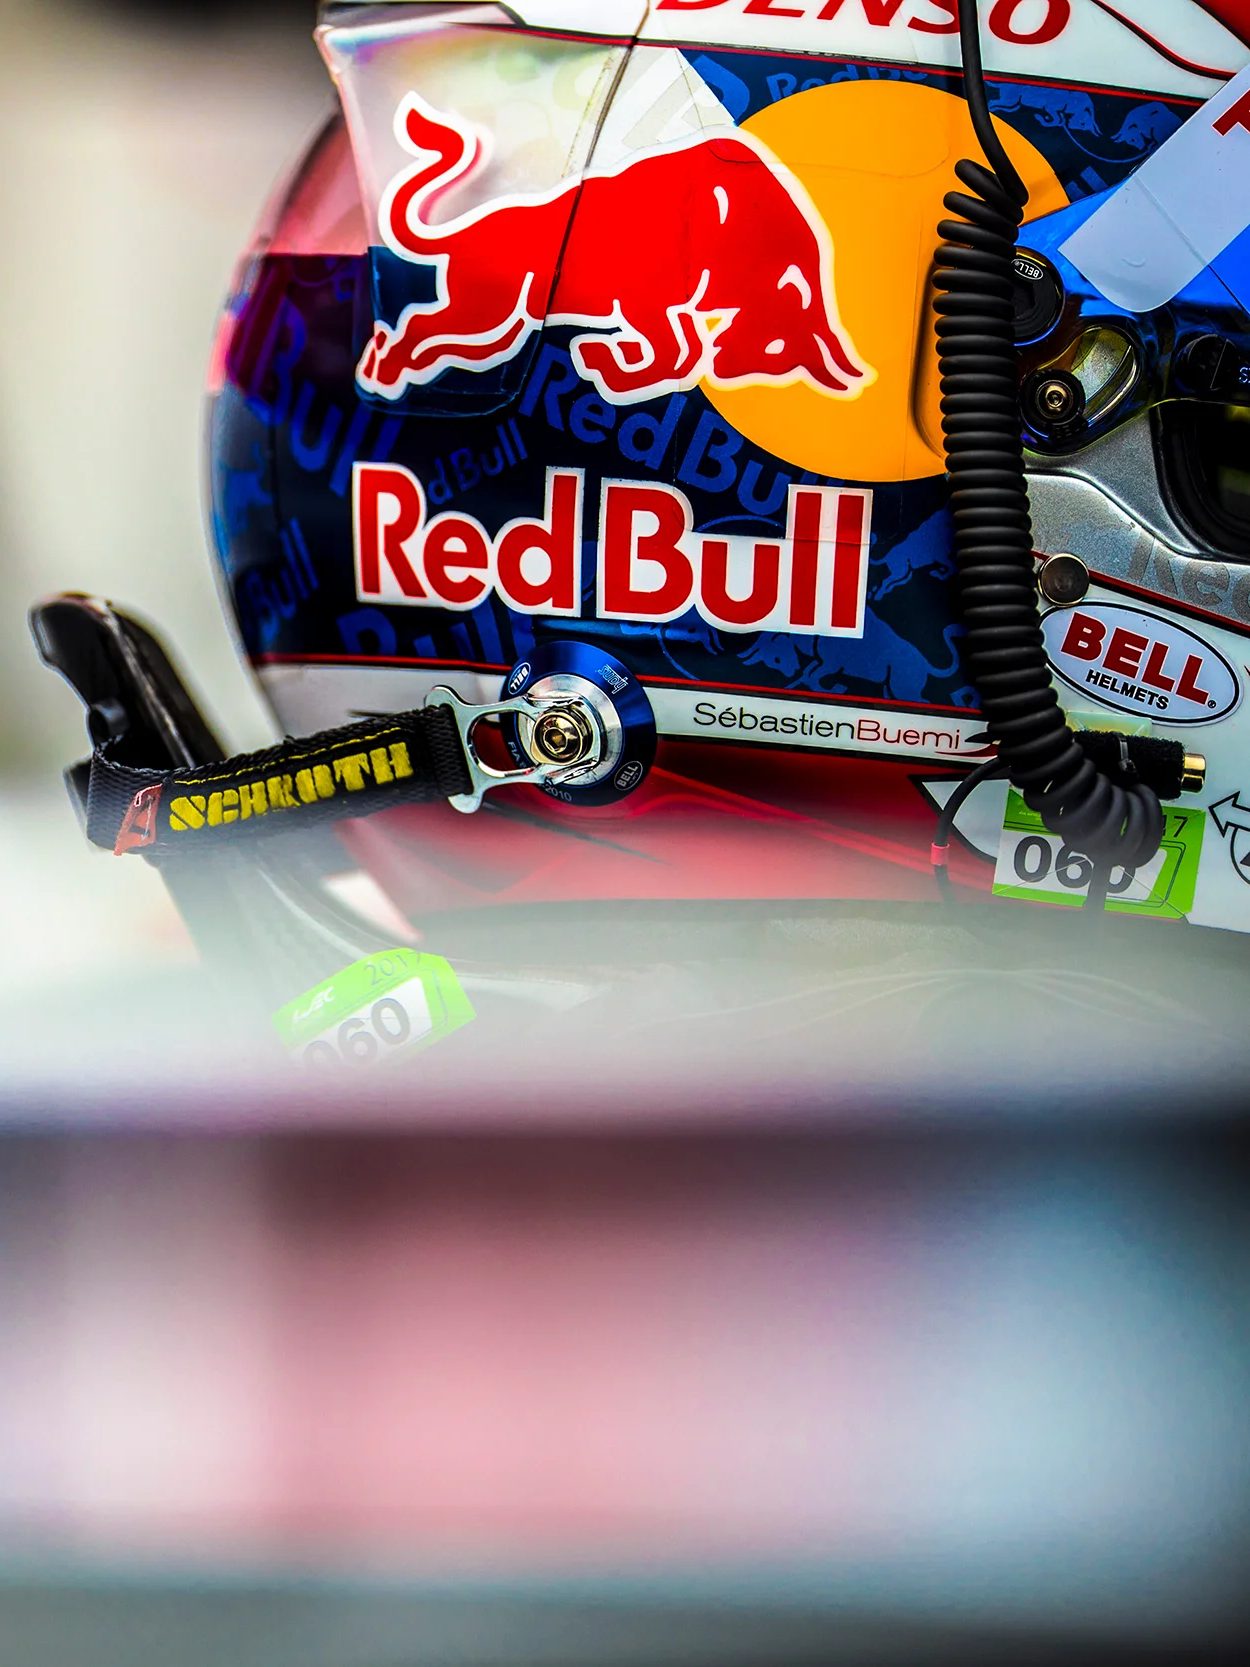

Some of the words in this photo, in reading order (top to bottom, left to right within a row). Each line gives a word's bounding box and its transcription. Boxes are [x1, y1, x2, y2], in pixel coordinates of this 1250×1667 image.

[1019, 262, 1040, 279] BELL
[449, 417, 529, 493] Bull
[517, 342, 688, 471] Red
[676, 409, 846, 517] Bu
[358, 466, 578, 611] Red
[601, 485, 866, 631] Bull
[509, 666, 530, 691] BELL
[1060, 611, 1209, 706] BELL
[1085, 669, 1169, 710] HELMETS
[168, 741, 414, 832] SCHROTH
[615, 764, 639, 788] BELL
